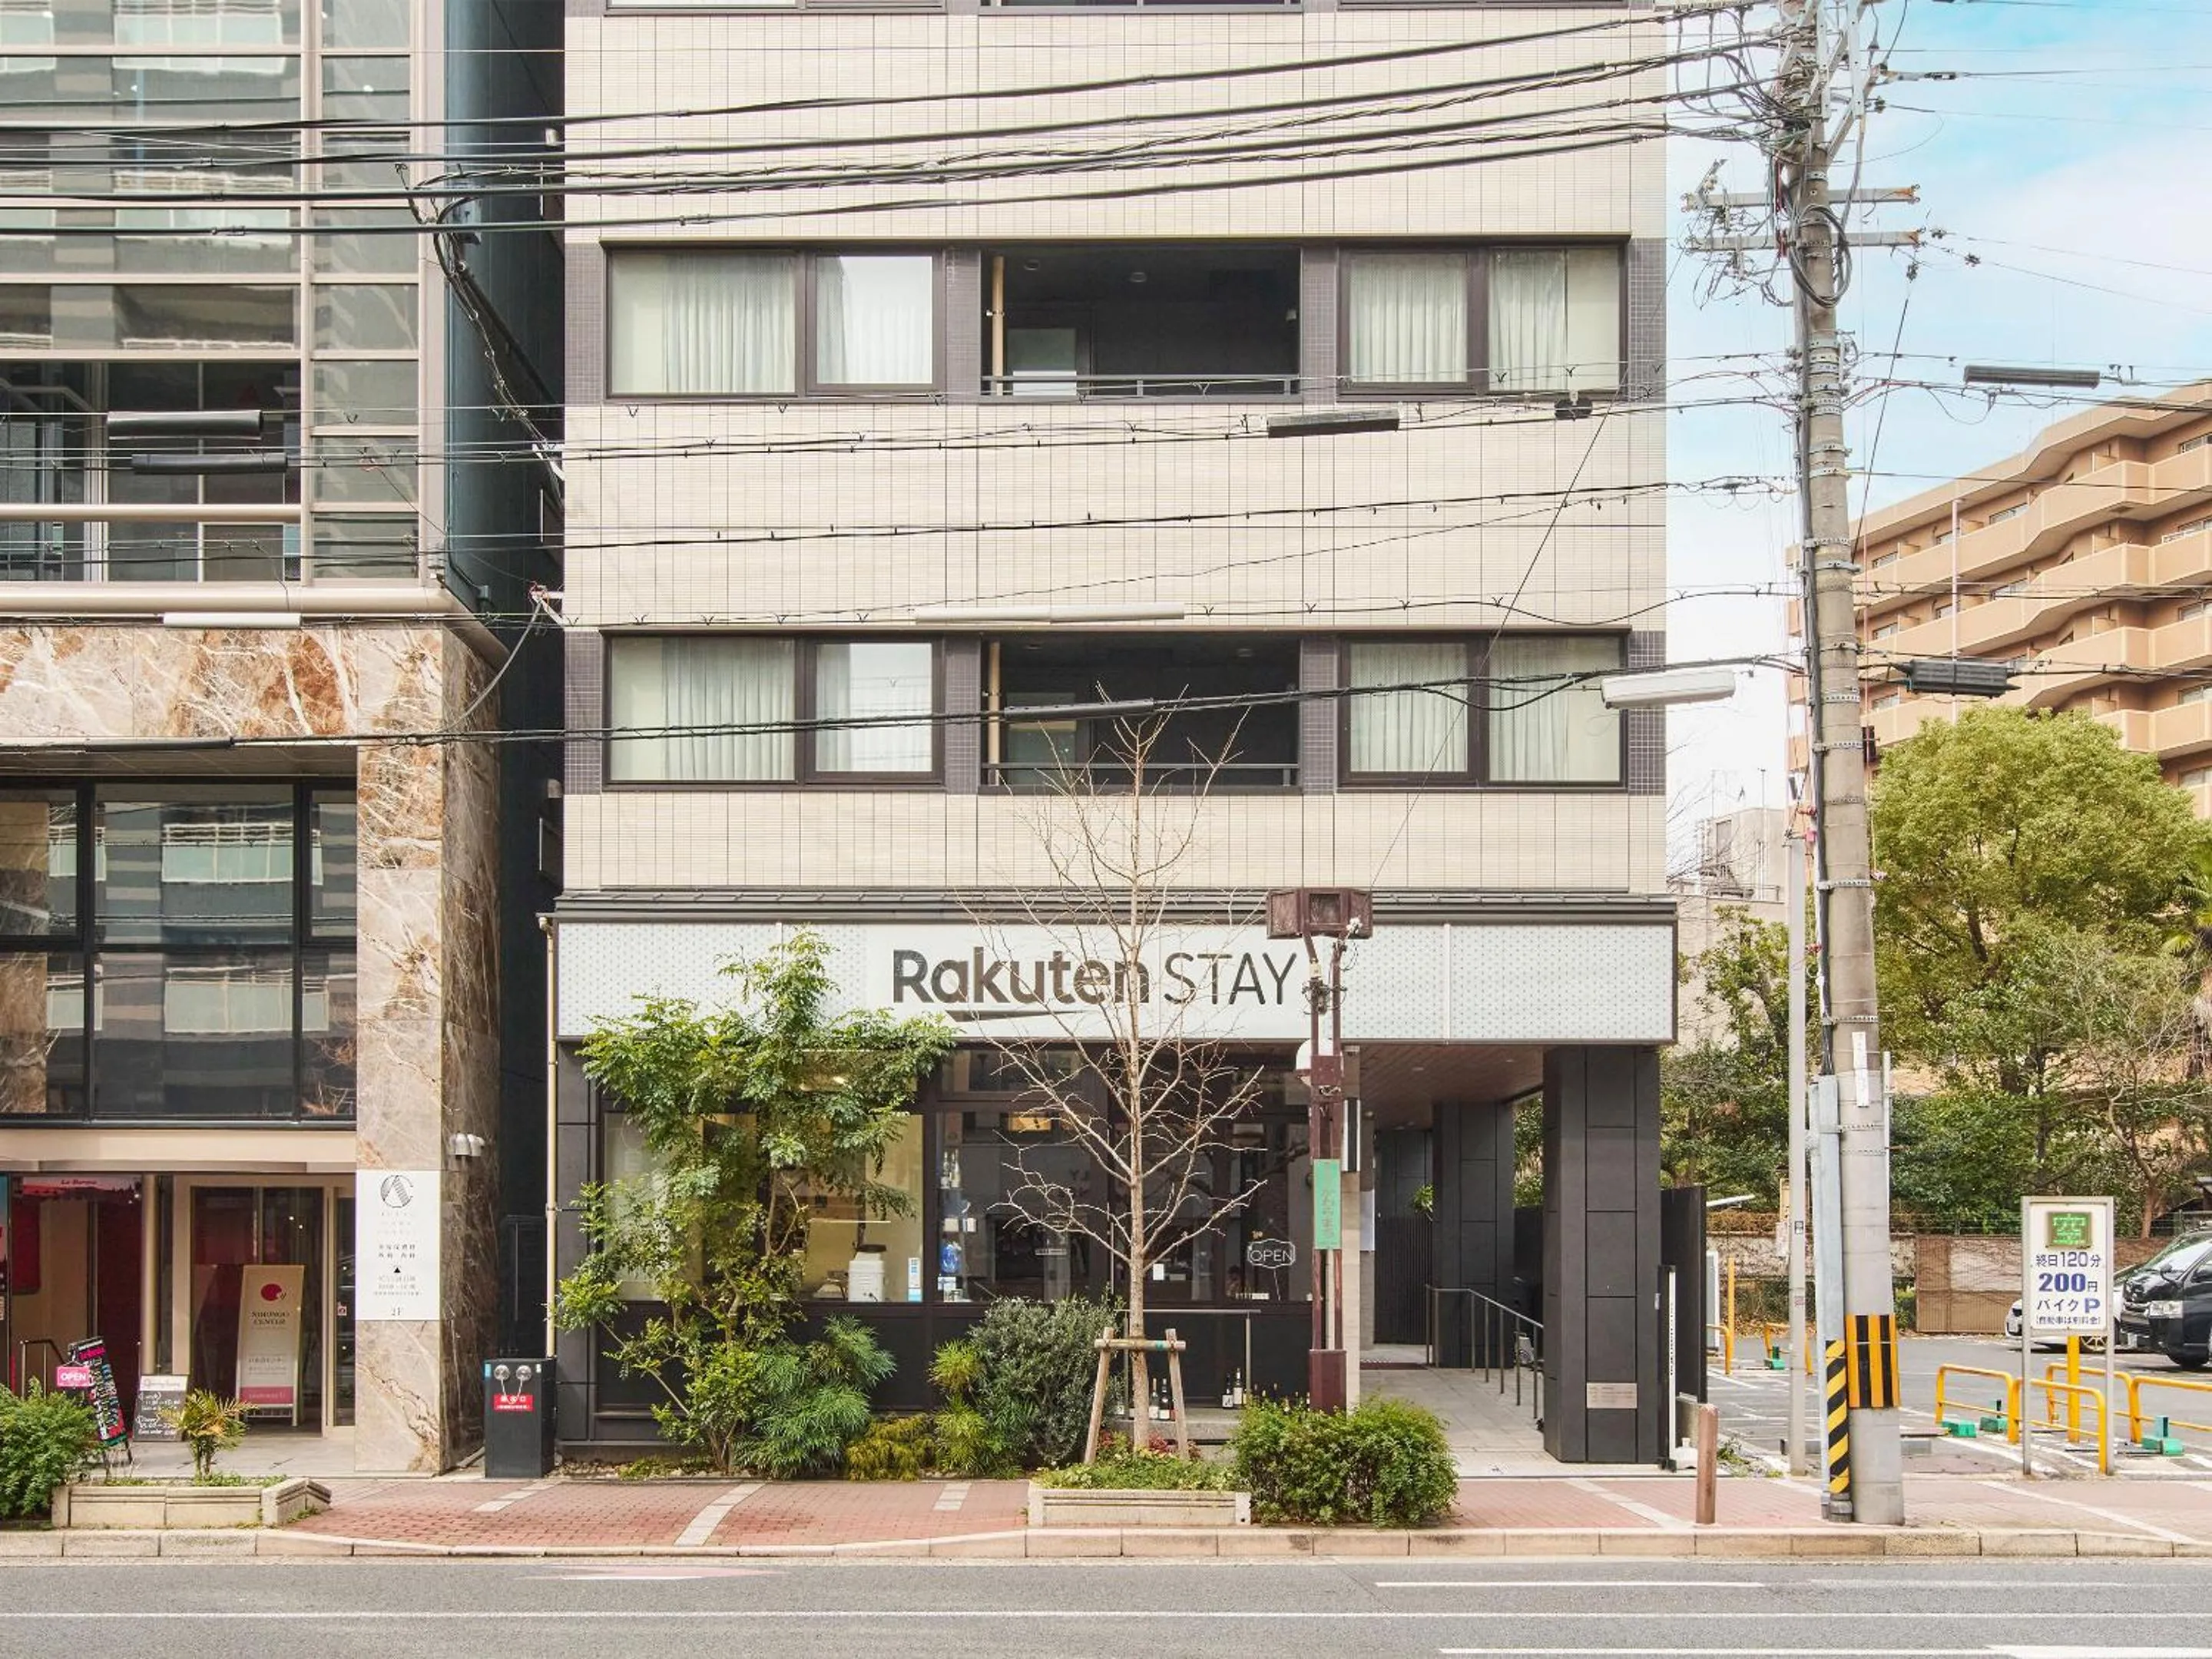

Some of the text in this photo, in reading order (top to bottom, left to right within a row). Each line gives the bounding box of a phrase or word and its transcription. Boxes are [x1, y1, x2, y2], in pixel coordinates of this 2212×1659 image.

[892, 945, 1297, 1005] Rakuten STAY
[1250, 1250, 1293, 1262] OPEN
[2035, 1251, 2101, 1268] 終日120分
[2038, 1272, 2098, 1293] 200円
[61, 1372, 87, 1381] OPEN
